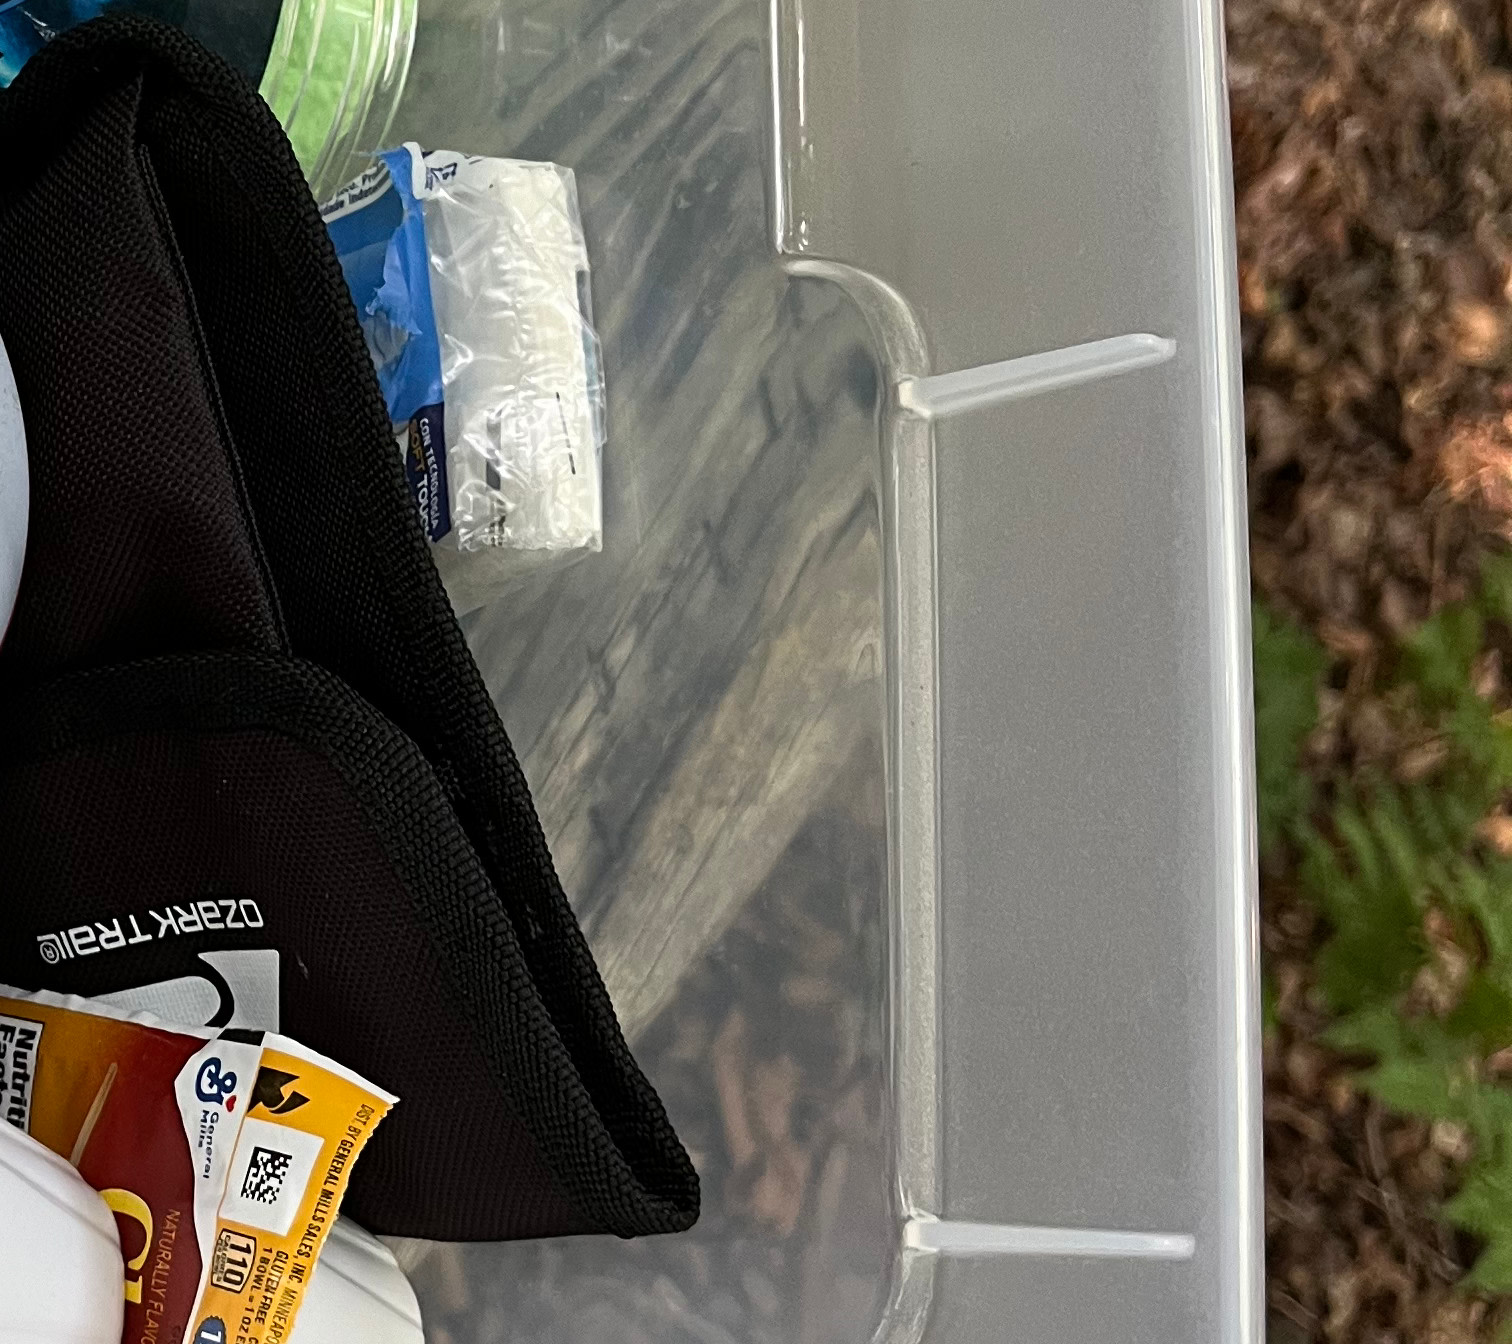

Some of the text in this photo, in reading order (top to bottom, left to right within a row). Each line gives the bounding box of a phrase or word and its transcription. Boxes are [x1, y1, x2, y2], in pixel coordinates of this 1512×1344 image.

[202, 1110, 220, 1180] General
[323, 1139, 355, 1187] GENERAL
[311, 1188, 335, 1224] MILLS
[149, 1209, 182, 1295] NATURALLY
[223, 1241, 252, 1288] 110
[293, 1223, 322, 1259] SALES,
[250, 1255, 271, 1293] BOWL
[254, 1250, 289, 1326] GLUTEN FREE
